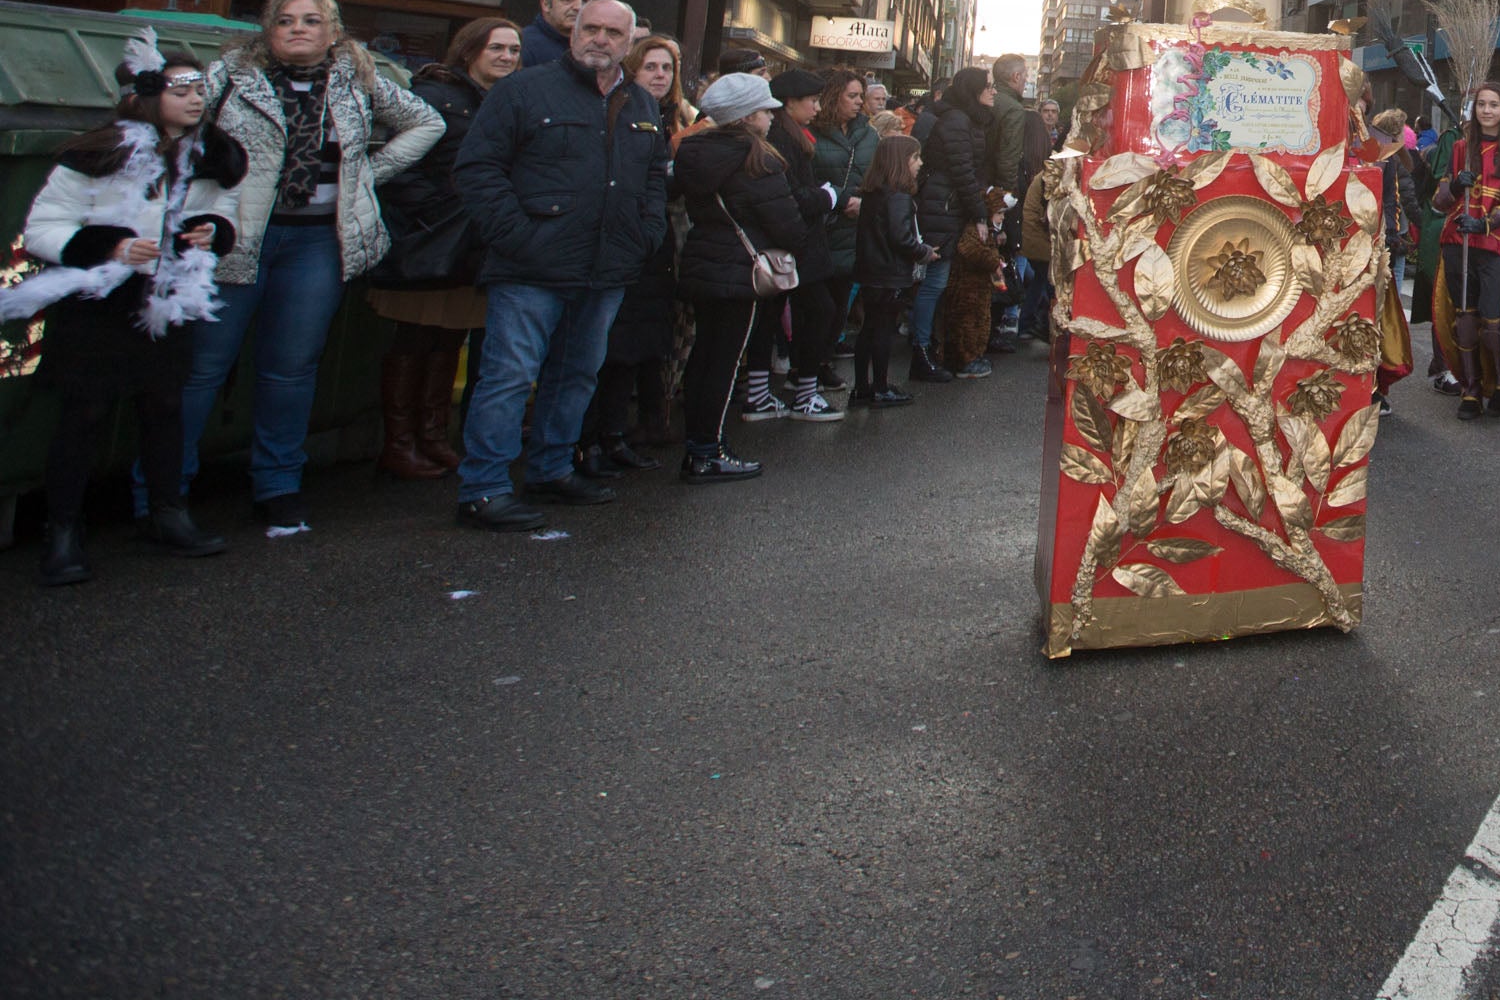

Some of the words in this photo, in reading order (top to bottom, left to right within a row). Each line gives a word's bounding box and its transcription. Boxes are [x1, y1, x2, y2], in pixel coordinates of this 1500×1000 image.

[848, 22, 888, 38] Mara
[813, 34, 889, 50] DECORACION
[1220, 87, 1304, 116] CLÉMATITE
